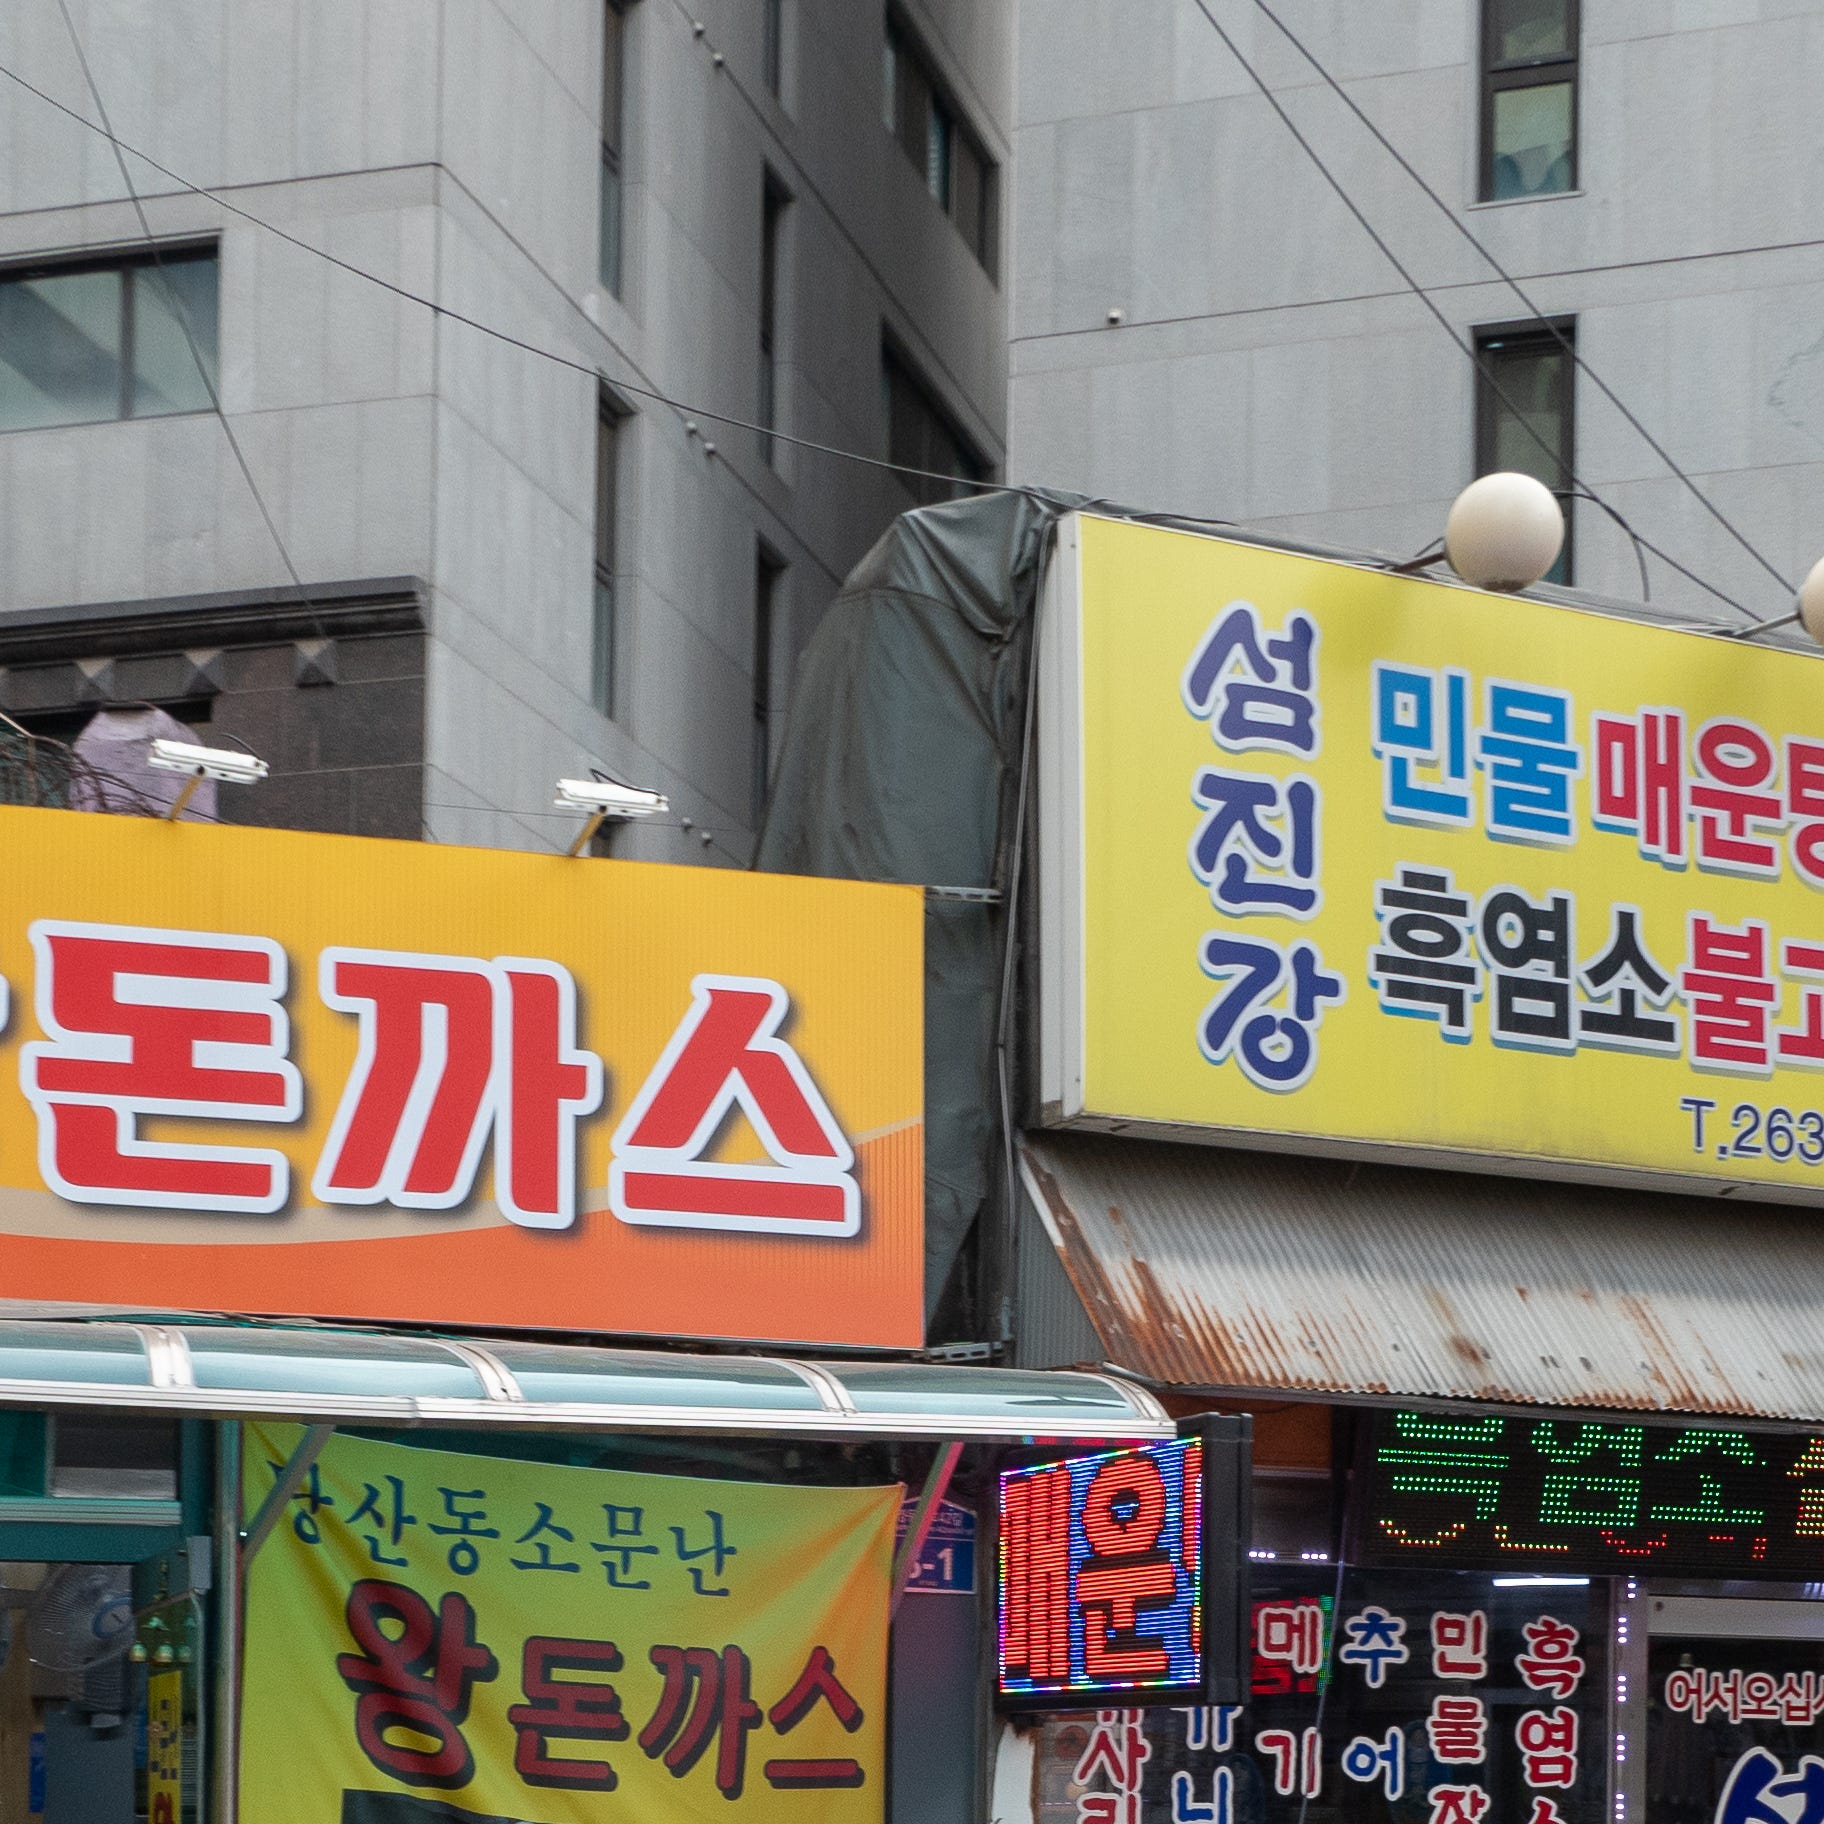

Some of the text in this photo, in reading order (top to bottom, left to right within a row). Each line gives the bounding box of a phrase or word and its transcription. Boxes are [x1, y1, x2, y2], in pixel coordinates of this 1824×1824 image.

[1181, 600, 1346, 1092] 섬진강
[1001, 1447, 1202, 1678] 매운
[337, 1577, 865, 1798] 왕돈까스
